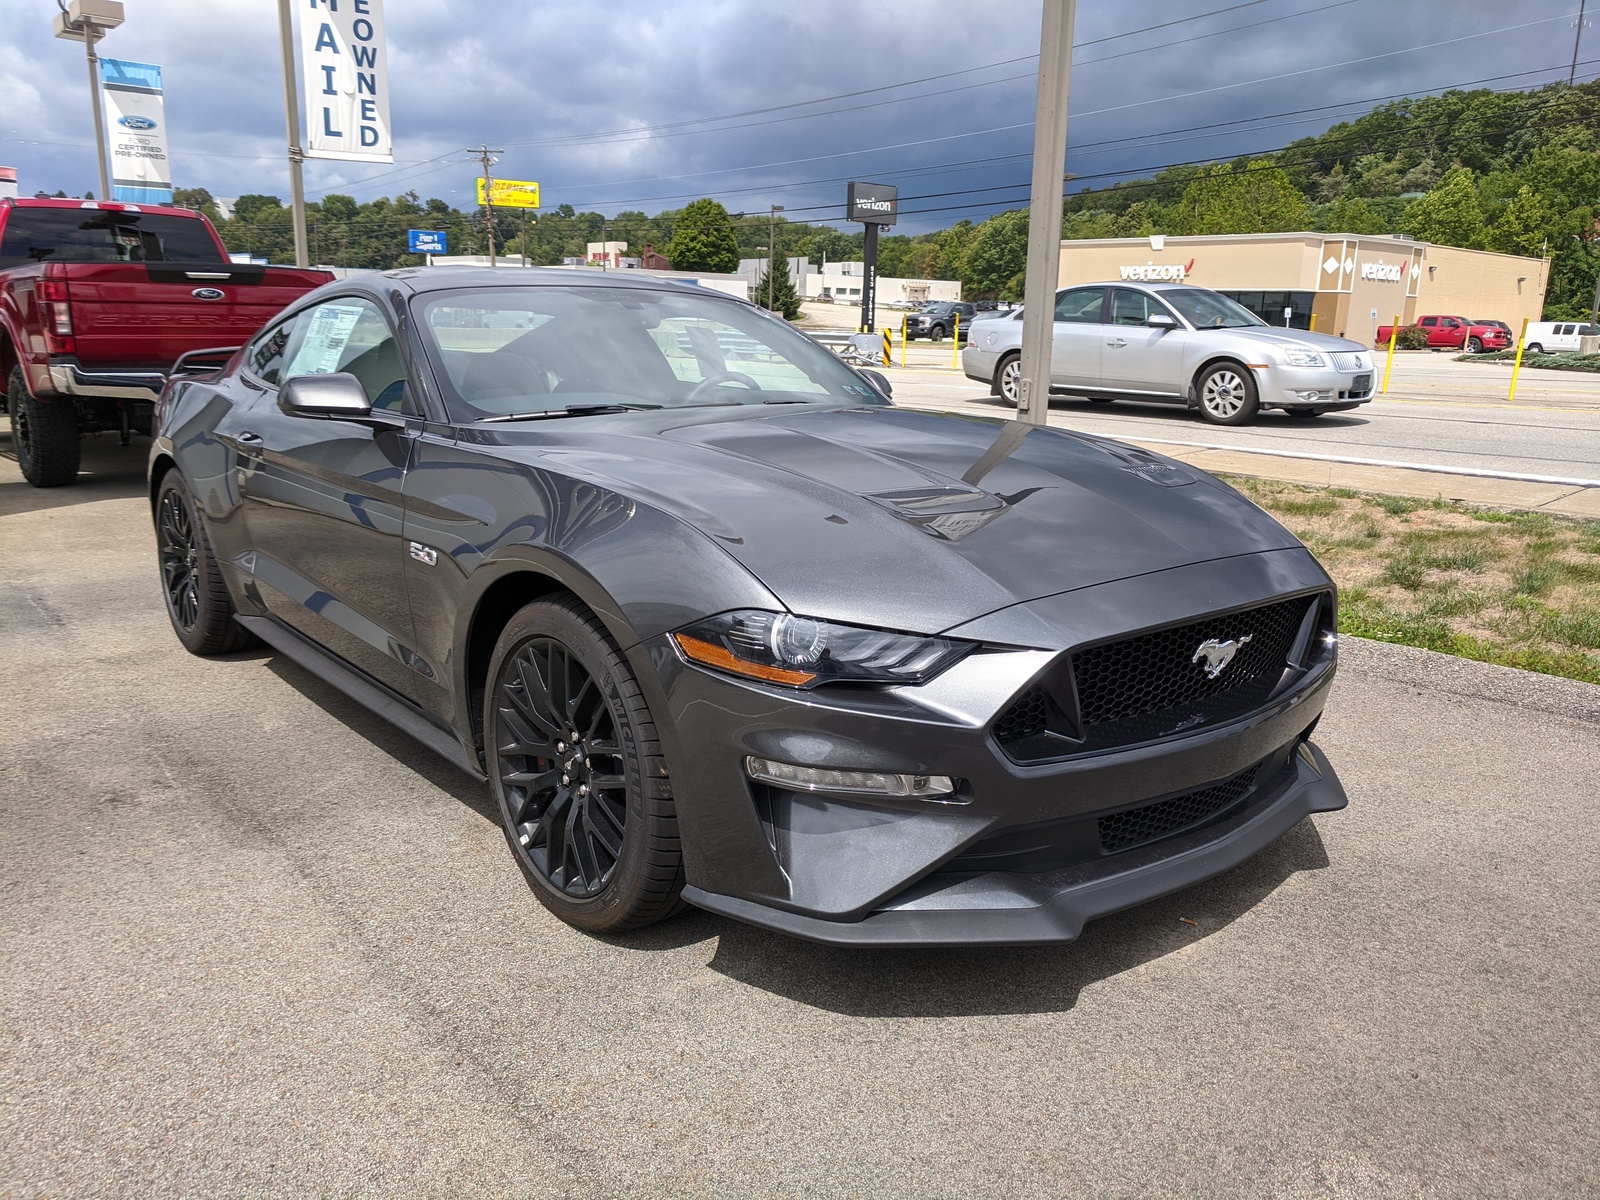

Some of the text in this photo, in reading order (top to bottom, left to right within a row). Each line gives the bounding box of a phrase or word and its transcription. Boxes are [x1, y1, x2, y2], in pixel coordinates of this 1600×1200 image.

[118, 143, 162, 153] CERTIFIED
[128, 137, 151, 146] FORD
[114, 150, 166, 160] PRE-OWNED
[856, 197, 891, 211] verizon
[1119, 260, 1185, 280] verizon
[1361, 259, 1401, 281] verizon
[97, 314, 222, 326] SUPER
[611, 697, 642, 812] MICHELIN
